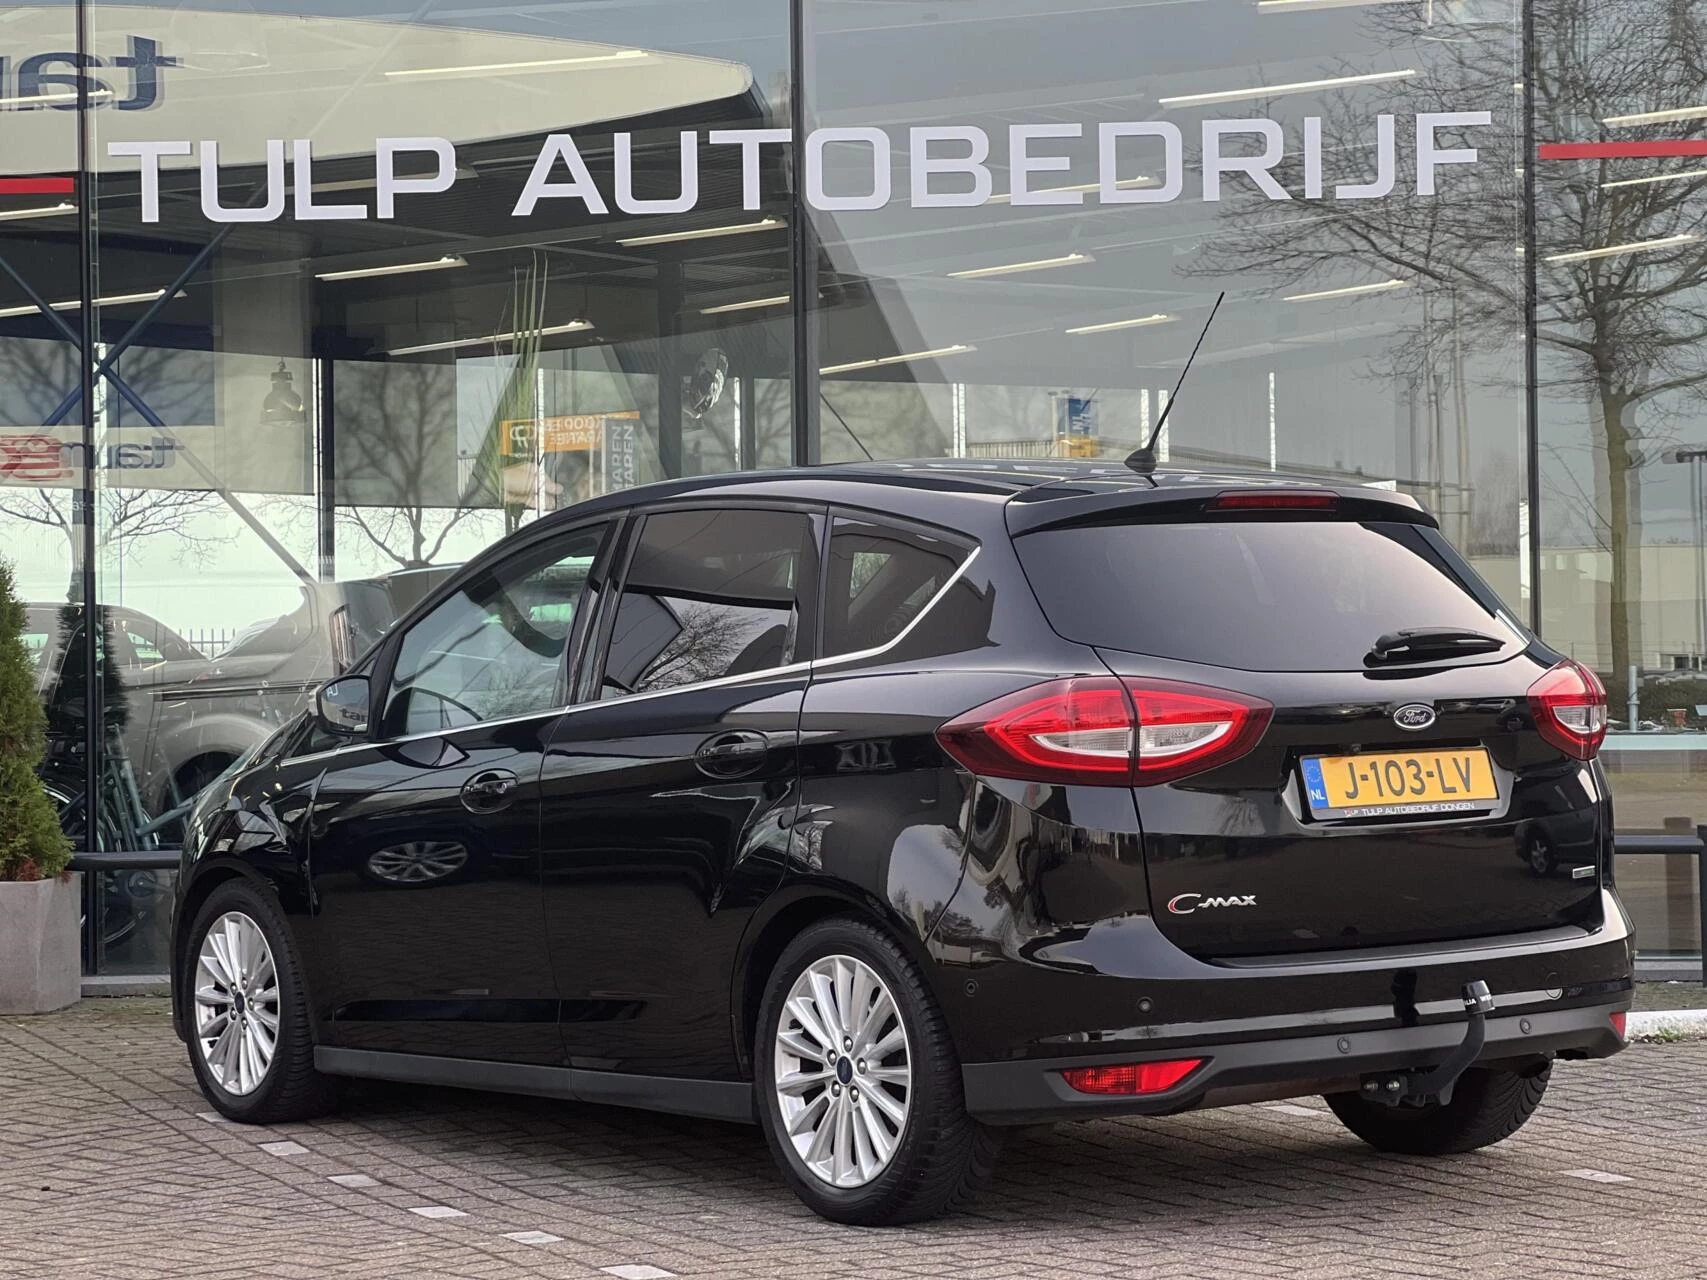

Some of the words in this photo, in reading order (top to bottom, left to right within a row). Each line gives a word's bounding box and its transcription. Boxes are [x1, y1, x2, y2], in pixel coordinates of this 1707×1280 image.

[108, 137, 456, 223] TULP
[511, 111, 1492, 216] AUTOBEDRIJF
[1311, 789, 1325, 801] NL
[1345, 757, 1471, 799] J-103-LV
[1361, 807, 1383, 816] TULP
[1440, 802, 1475, 812] DONGEN
